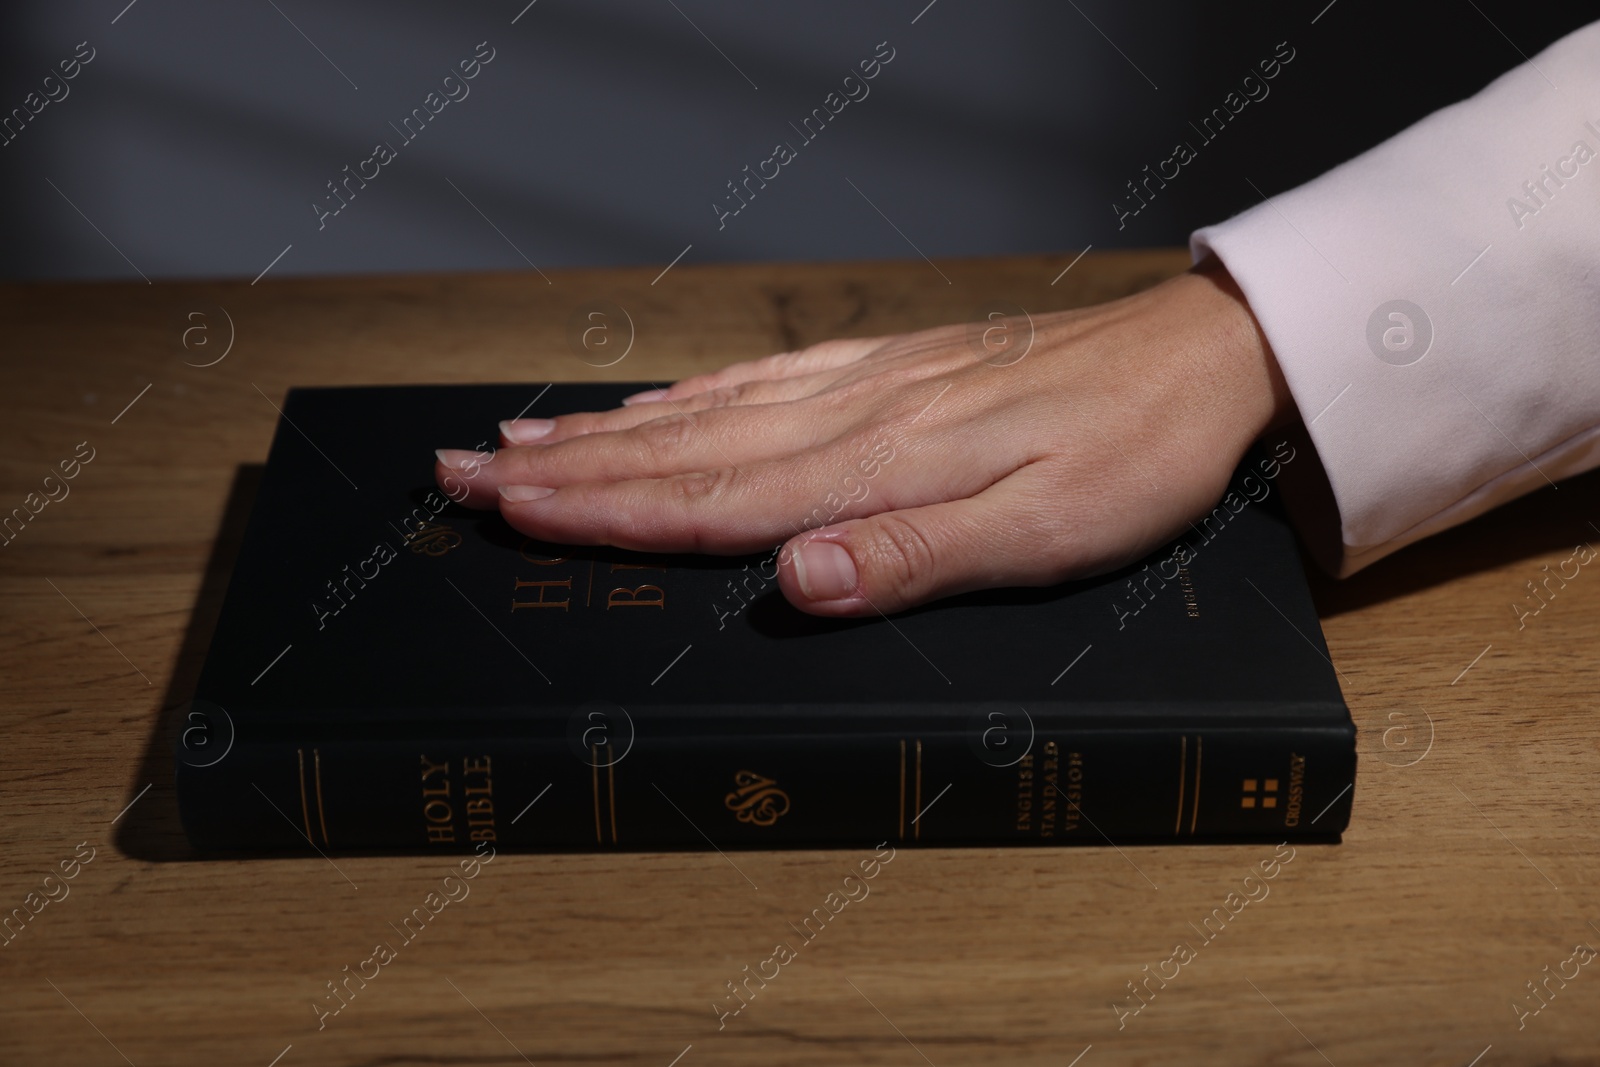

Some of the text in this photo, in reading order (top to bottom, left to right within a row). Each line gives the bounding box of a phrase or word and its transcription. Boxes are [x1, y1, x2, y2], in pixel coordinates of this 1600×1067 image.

[421, 754, 456, 843] HOLY
[463, 755, 497, 842] BIBLE
[1017, 754, 1034, 831] ENGLISH
[1041, 741, 1059, 838] STANDARD
[1065, 752, 1083, 832] VERSION
[1285, 751, 1306, 828] CROSSWAY
